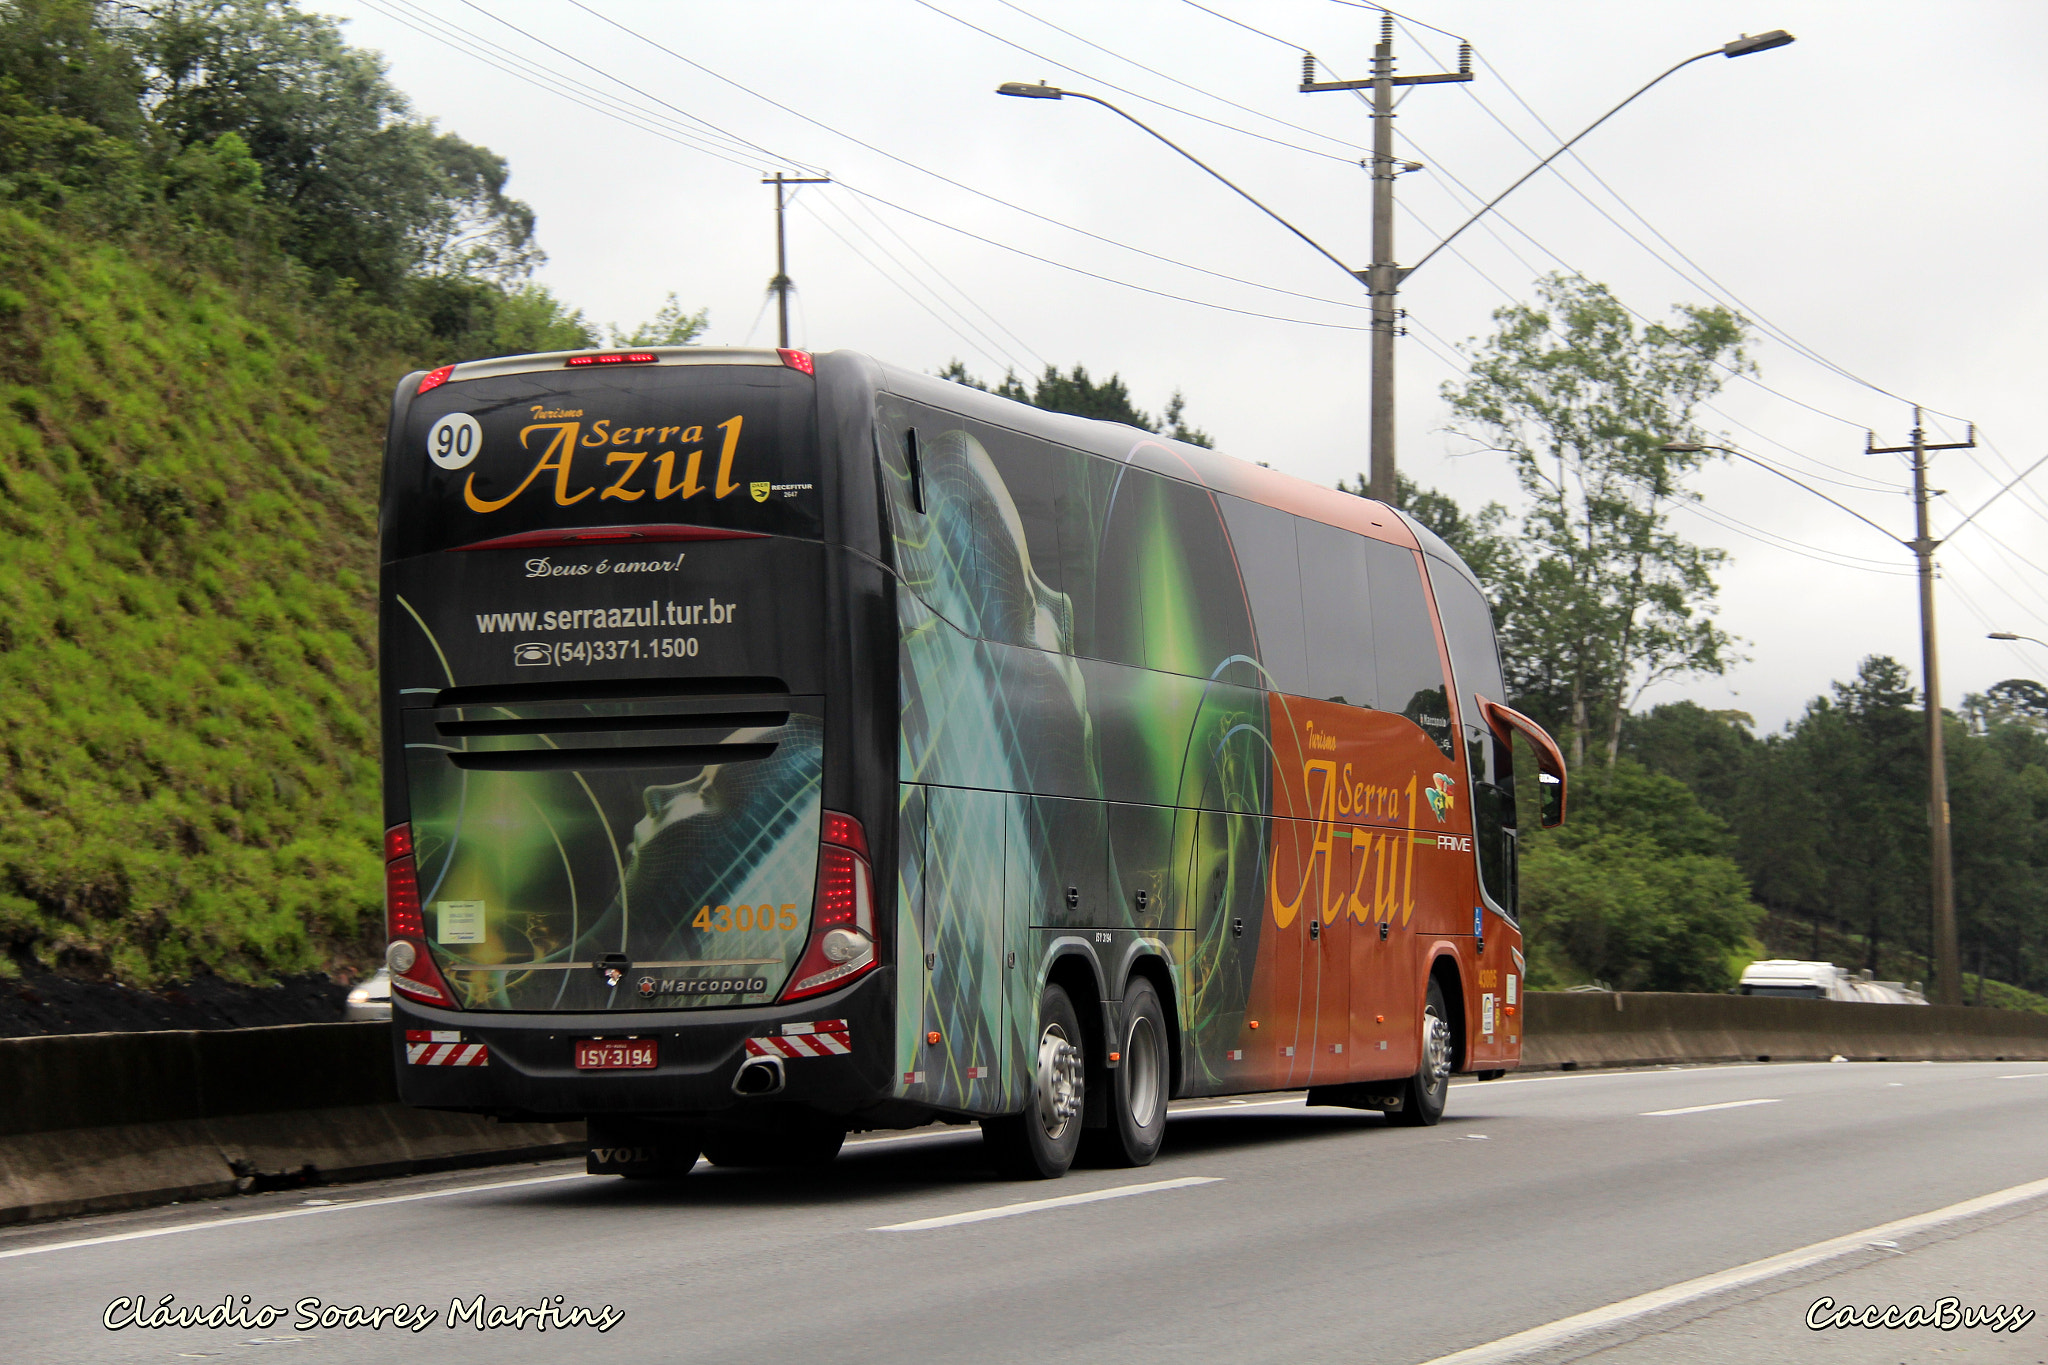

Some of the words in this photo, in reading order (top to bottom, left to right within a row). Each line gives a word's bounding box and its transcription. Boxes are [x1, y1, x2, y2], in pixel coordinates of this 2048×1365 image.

[530, 405, 584, 420] Turismo
[436, 424, 472, 458] 90
[581, 420, 704, 447] Serra
[464, 415, 743, 513] Azul
[525, 557, 593, 578] Deus
[596, 559, 612, 574] é
[613, 553, 686, 573] amor!
[476, 598, 736, 634] www.serraazul.tur.br
[554, 638, 699, 667] (54)3371.1500
[1306, 720, 1336, 751] Turismo
[1338, 763, 1400, 823] Serra
[1271, 759, 1417, 930] Azul
[692, 904, 798, 932] 43005
[660, 978, 764, 993] Marcopolo
